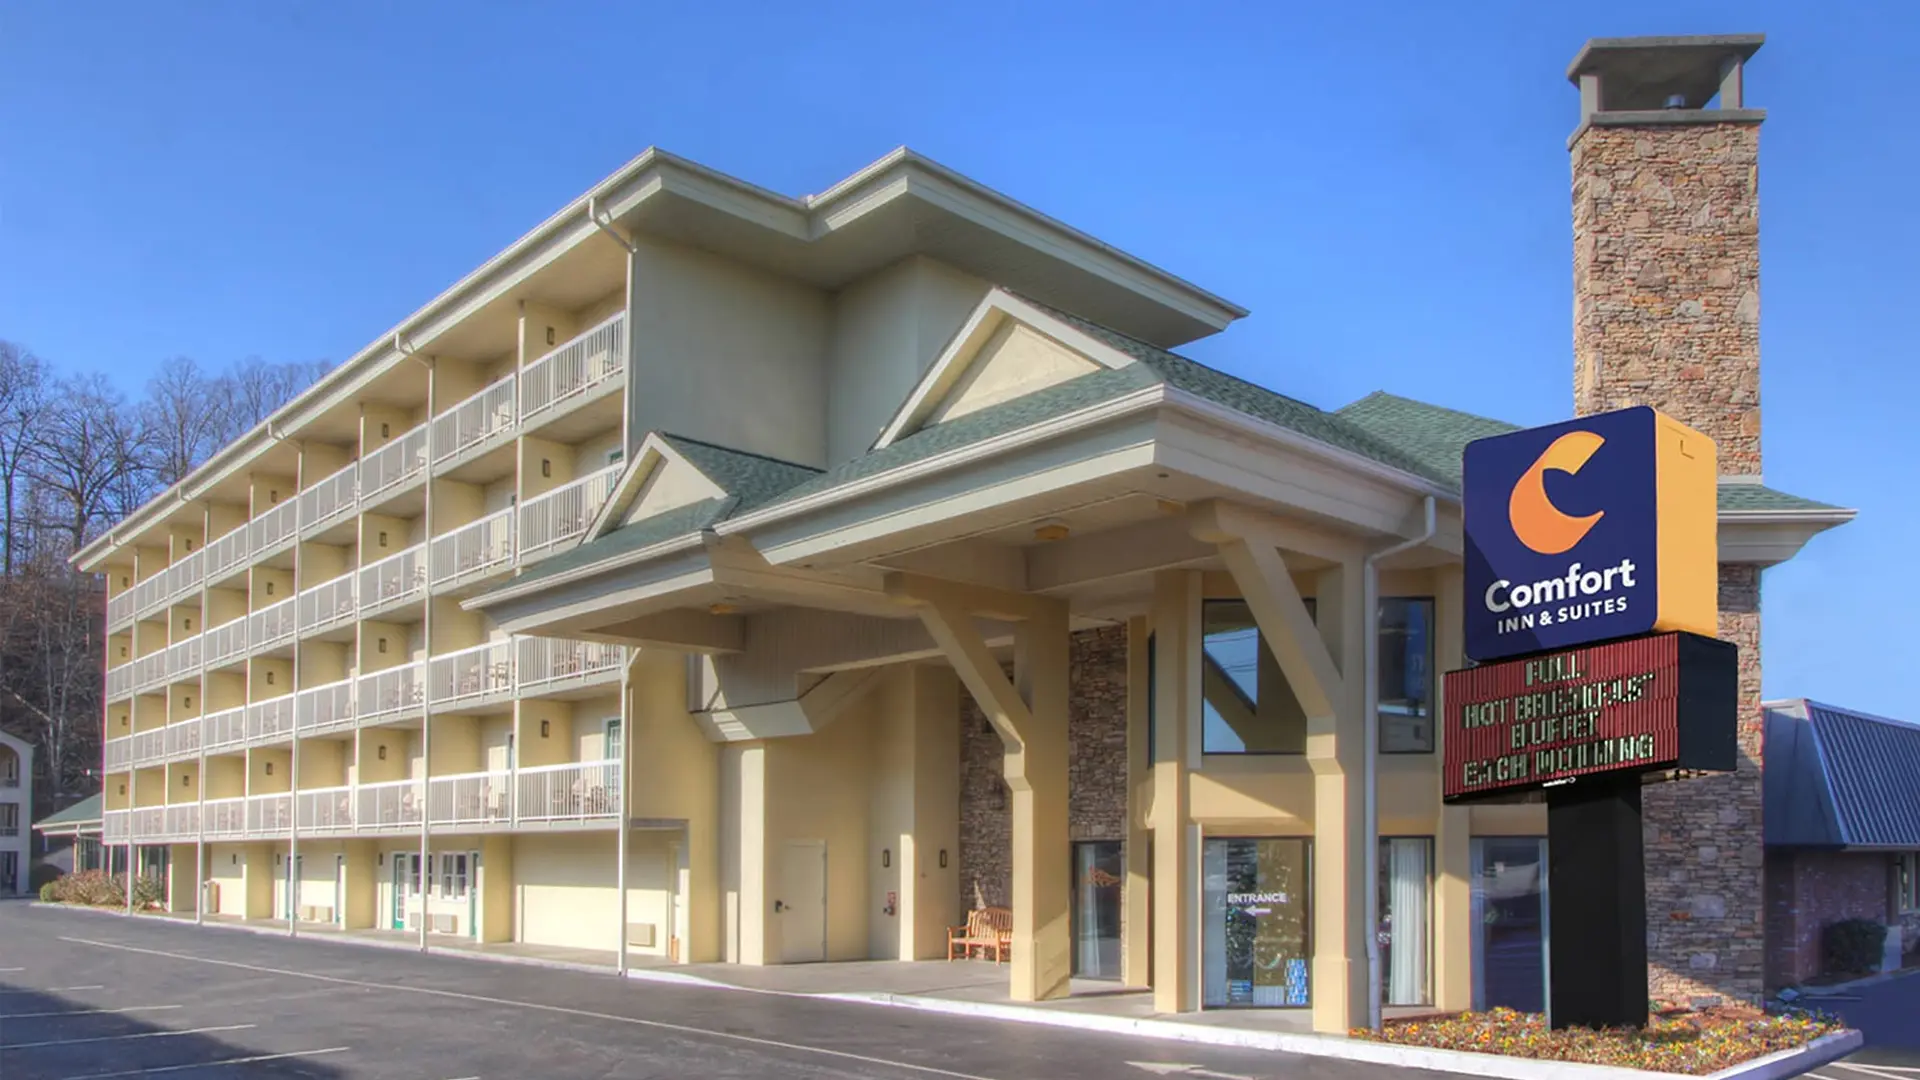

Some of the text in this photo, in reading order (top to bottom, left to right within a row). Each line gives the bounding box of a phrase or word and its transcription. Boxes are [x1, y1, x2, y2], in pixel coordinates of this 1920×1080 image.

[1485, 558, 1636, 613] Comfort
[1497, 596, 1628, 635] INN & SUITES
[1525, 652, 1583, 687] FULL
[1463, 698, 1510, 729] HOT
[1511, 710, 1600, 749] BUFFET
[1462, 752, 1528, 787] EACH
[1227, 892, 1288, 904] ENTRANCE
